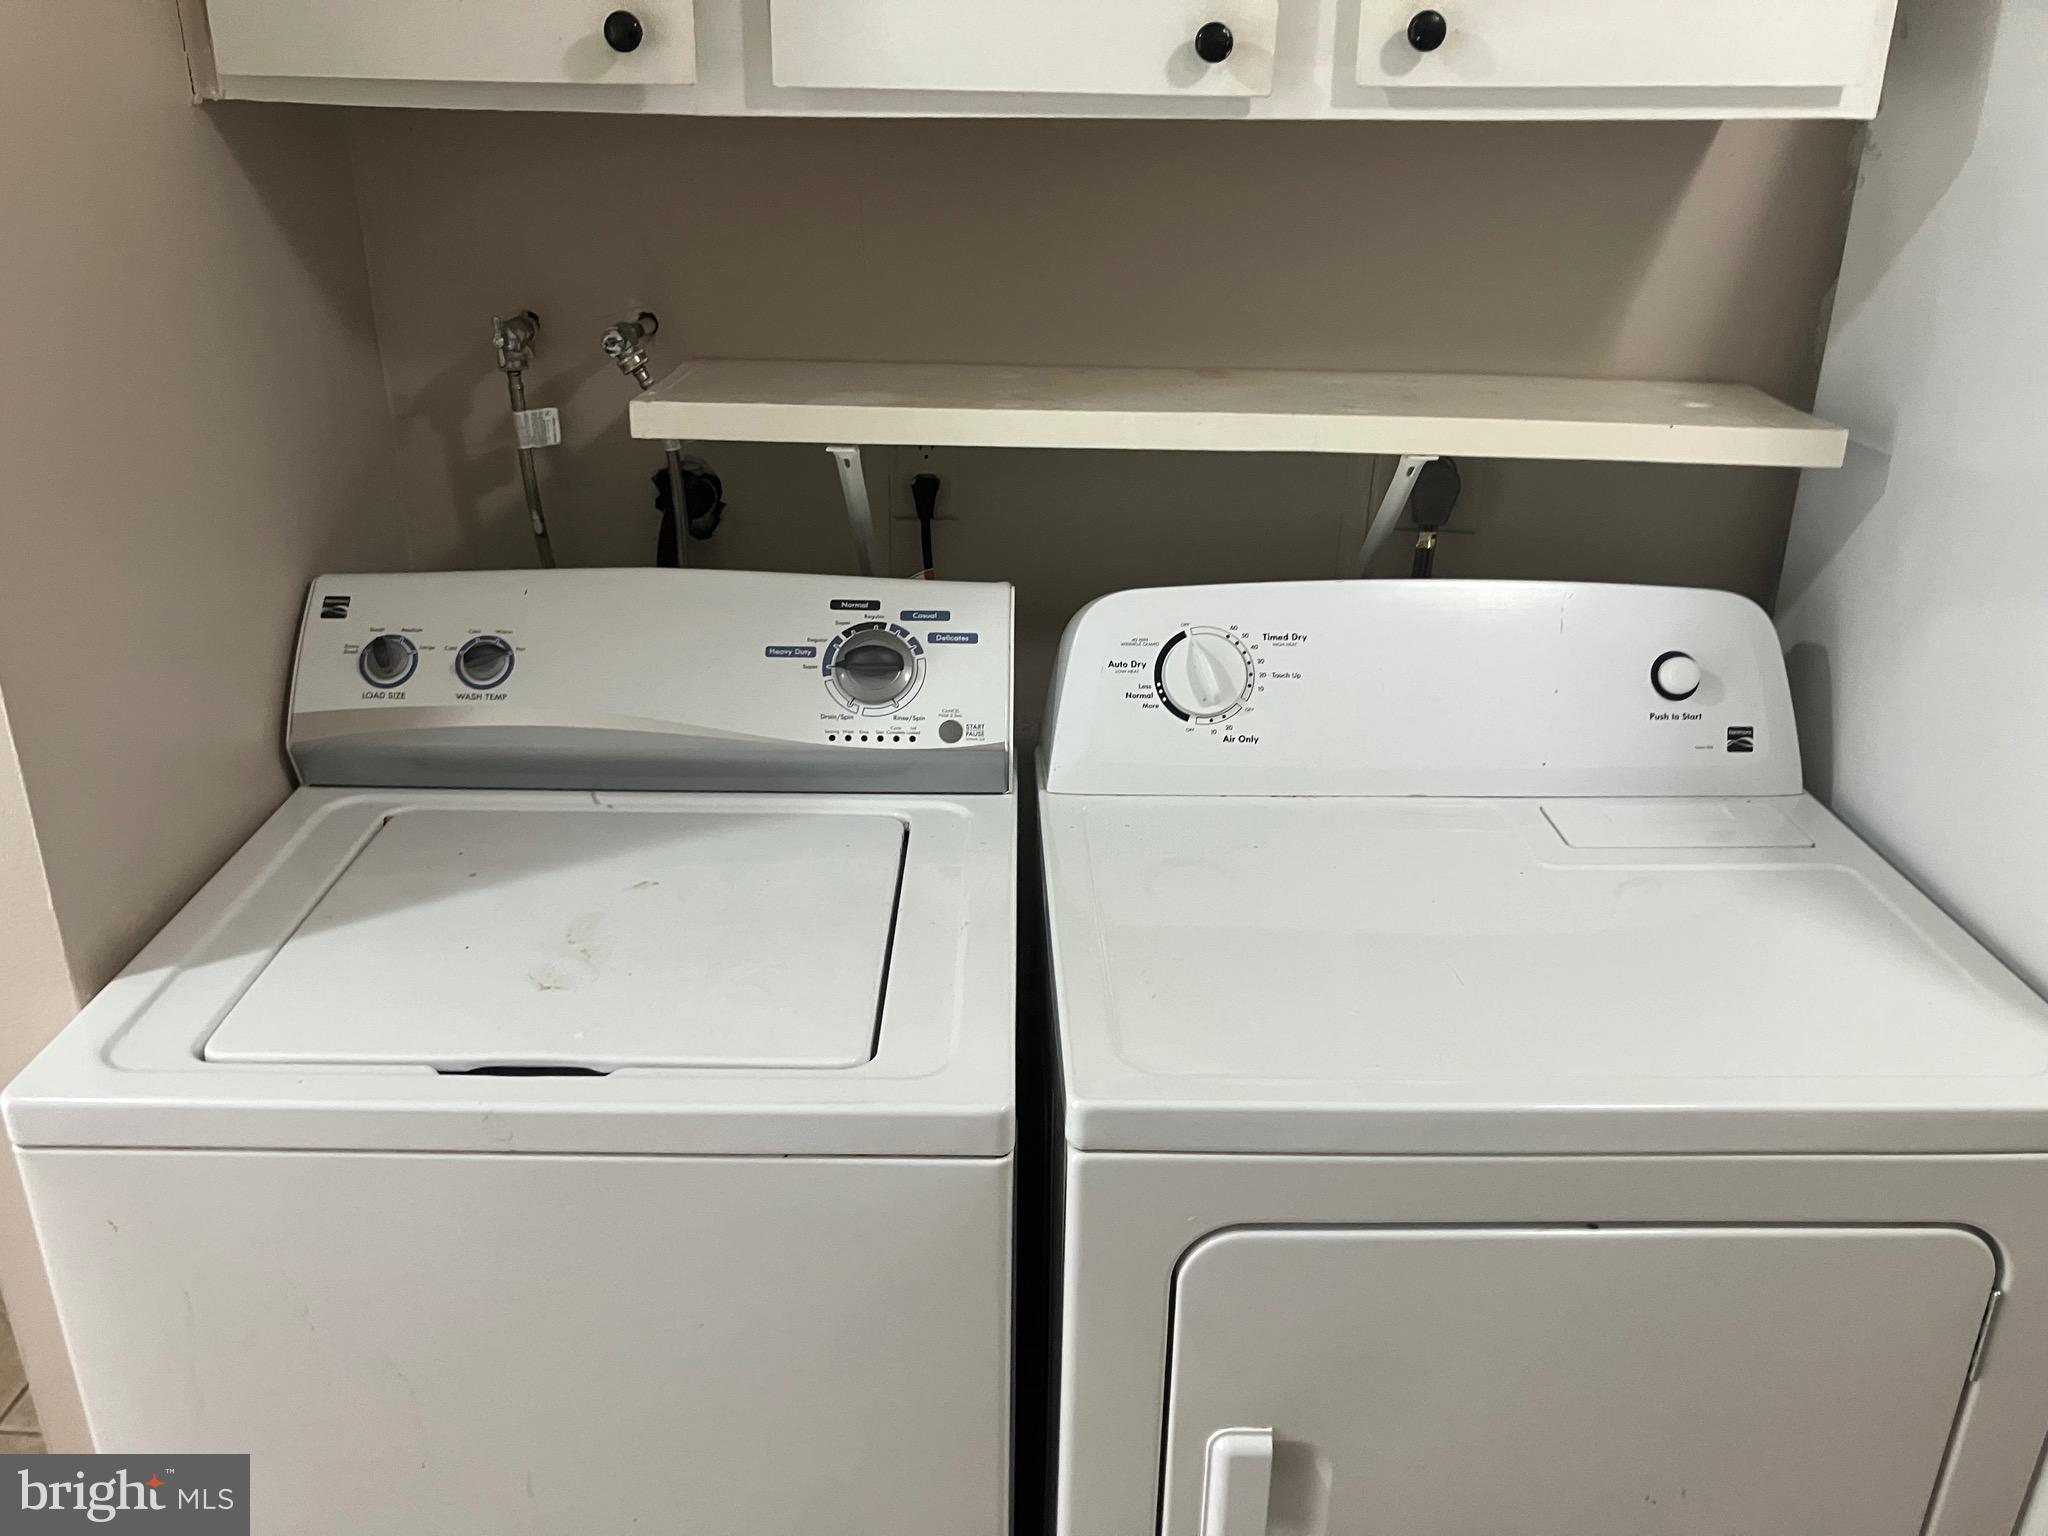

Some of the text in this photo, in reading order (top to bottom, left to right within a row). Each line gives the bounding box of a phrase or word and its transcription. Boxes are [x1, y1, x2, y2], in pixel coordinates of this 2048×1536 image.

[841, 600, 868, 608] Normal
[912, 612, 937, 620] Casual
[936, 634, 969, 642] Delicates
[1262, 633, 1308, 643] Timed Dry
[769, 648, 812, 657] Heavy Duty
[1108, 660, 1147, 670] Auto Dry
[820, 713, 854, 722] Drain/Spin
[893, 714, 926, 723] Rinse/Spin
[1649, 712, 1702, 720] Push to Start
[1222, 735, 1259, 745] Air Only
